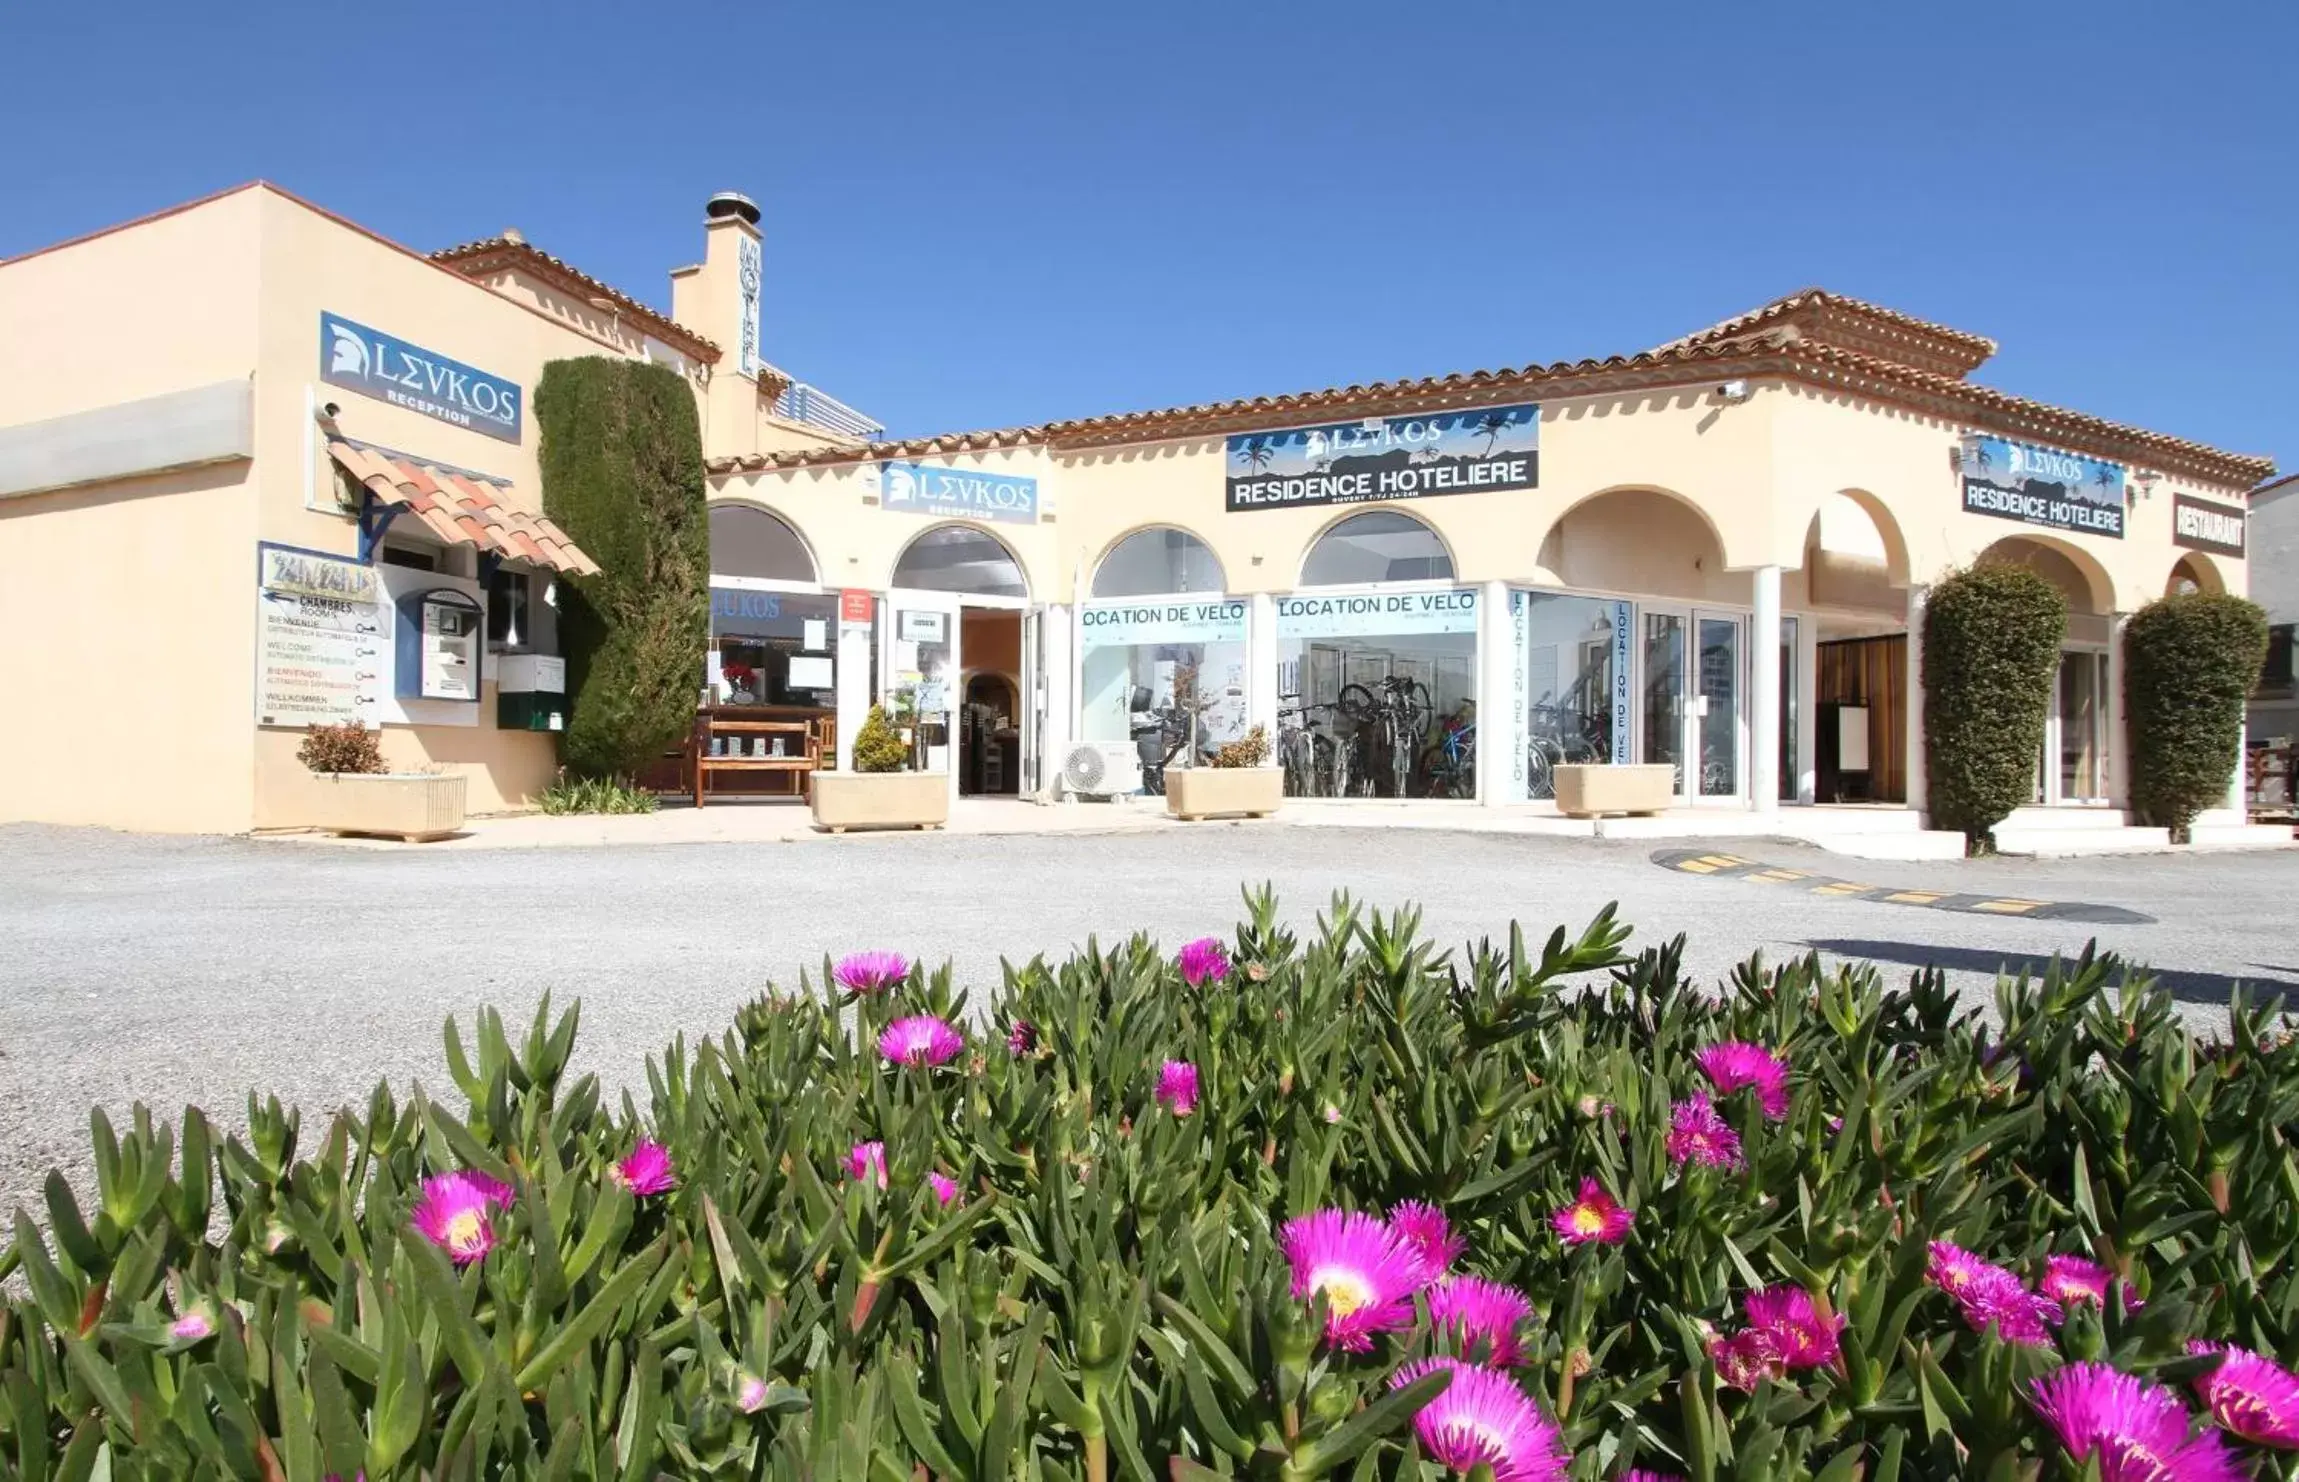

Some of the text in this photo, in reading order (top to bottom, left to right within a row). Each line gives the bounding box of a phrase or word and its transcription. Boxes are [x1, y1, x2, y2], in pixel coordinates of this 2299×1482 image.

[387, 389, 471, 426] RECEPTION
[1235, 460, 1528, 504] RESIDENCE HOTELIERE
[1967, 485, 2121, 532] RESIDENCE HOTELIERE
[2177, 504, 2243, 547] RESTAURANT
[1082, 604, 1244, 626] OCATION DE VELO
[1279, 593, 1475, 617] LOCATION DE VELO
[1618, 604, 1627, 697] LOCATION
[1514, 592, 1524, 781] LOCATION DE VELO
[1618, 704, 1626, 727] DE
